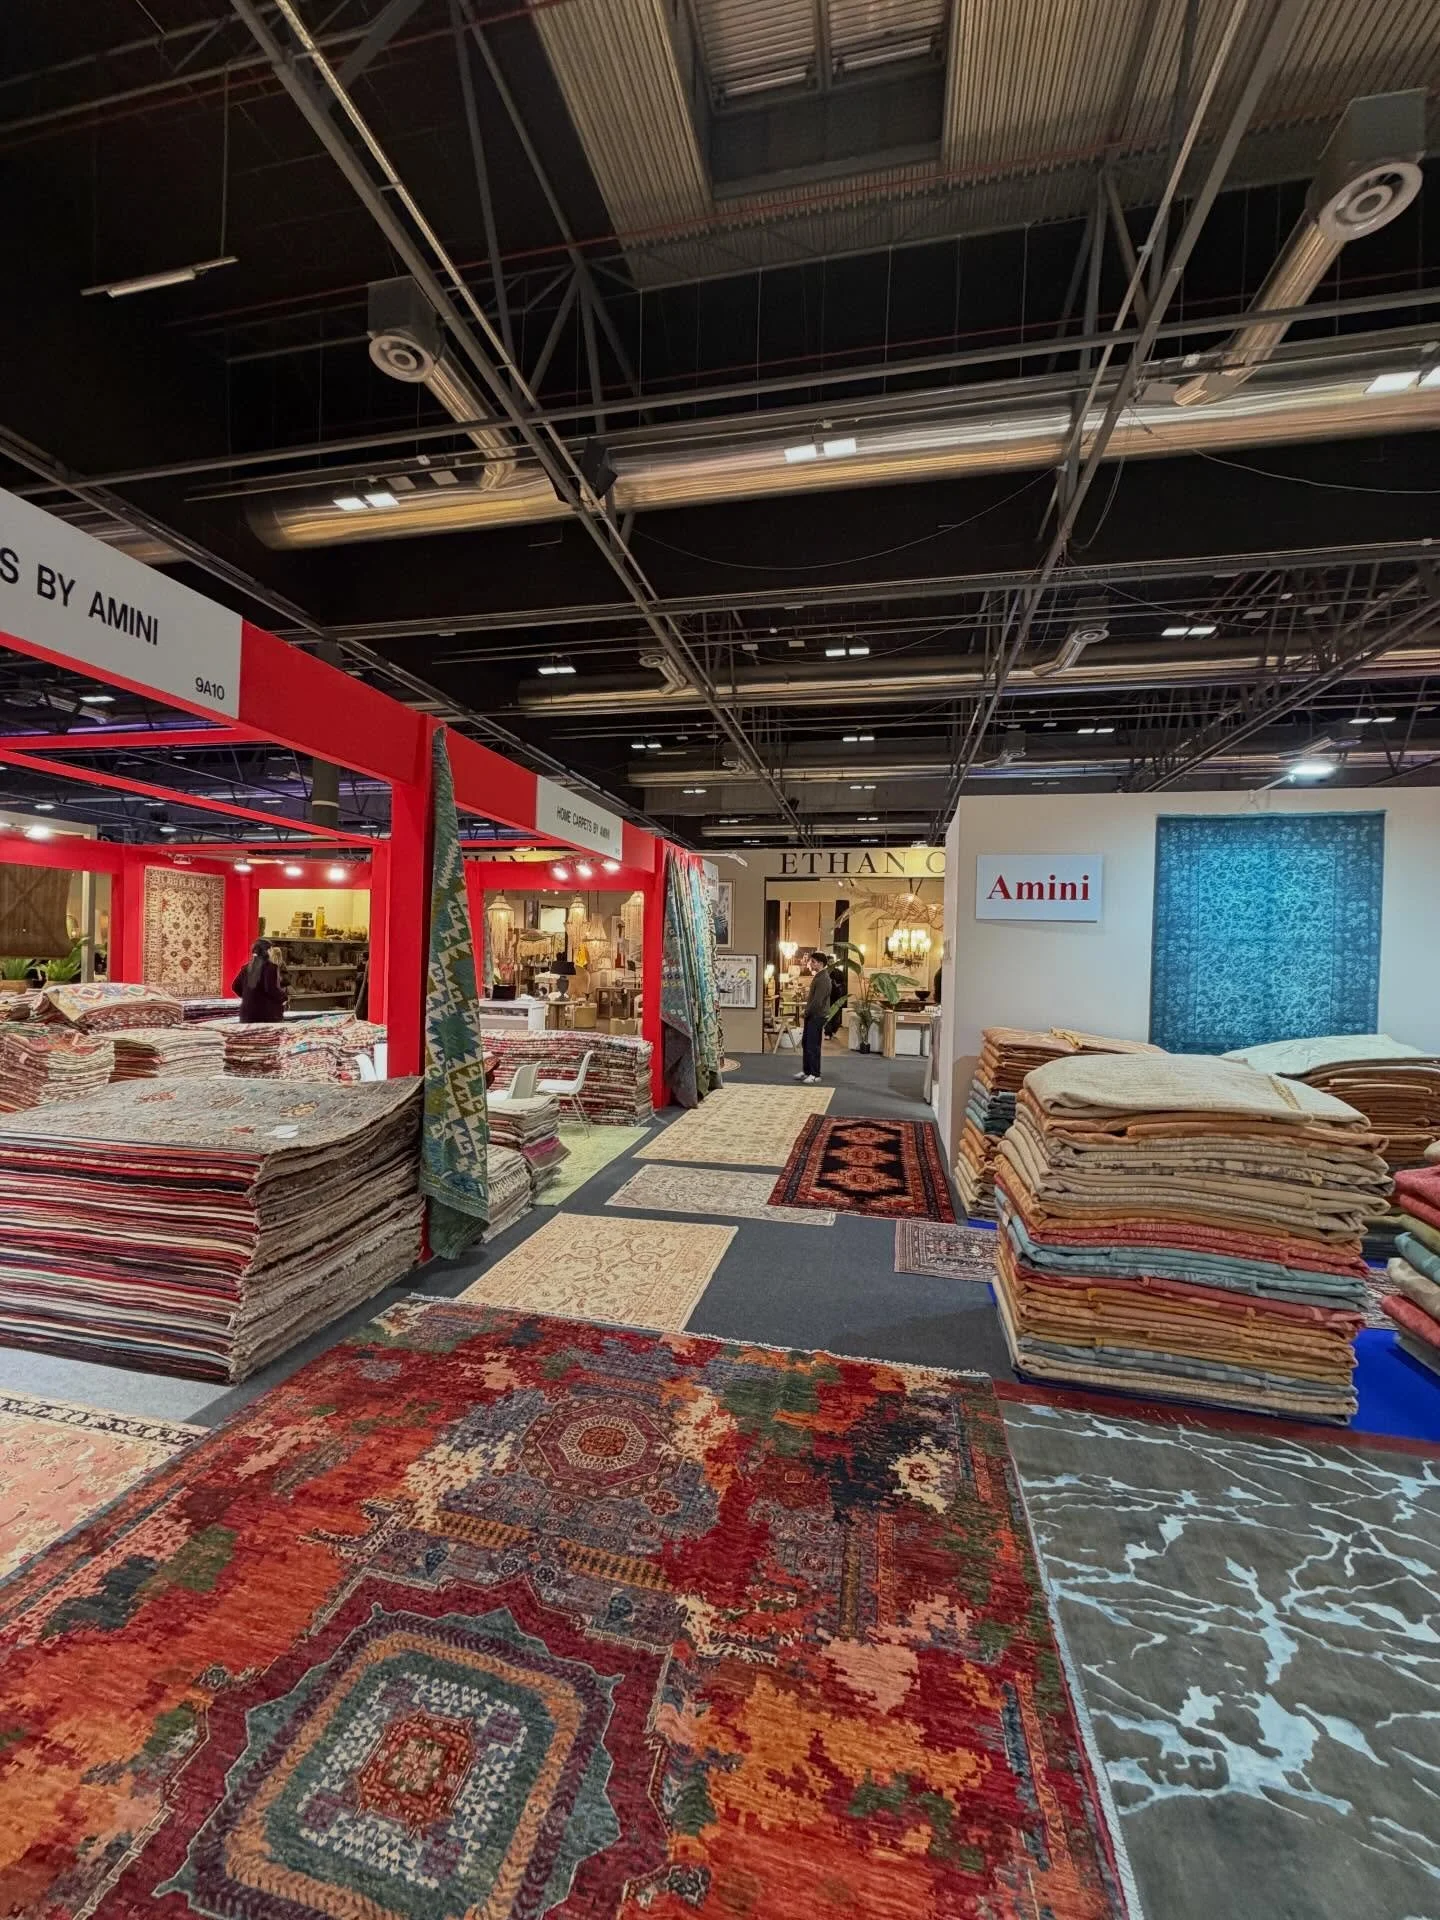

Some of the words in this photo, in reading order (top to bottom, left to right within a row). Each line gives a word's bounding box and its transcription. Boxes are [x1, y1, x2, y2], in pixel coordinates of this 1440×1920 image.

[37, 563, 76, 607] BY
[88, 591, 158, 646] AMINI
[195, 676, 225, 701] 9A10
[556, 805, 571, 824] HOME
[779, 851, 906, 875] ETHAN
[986, 874, 1091, 901] Amini
